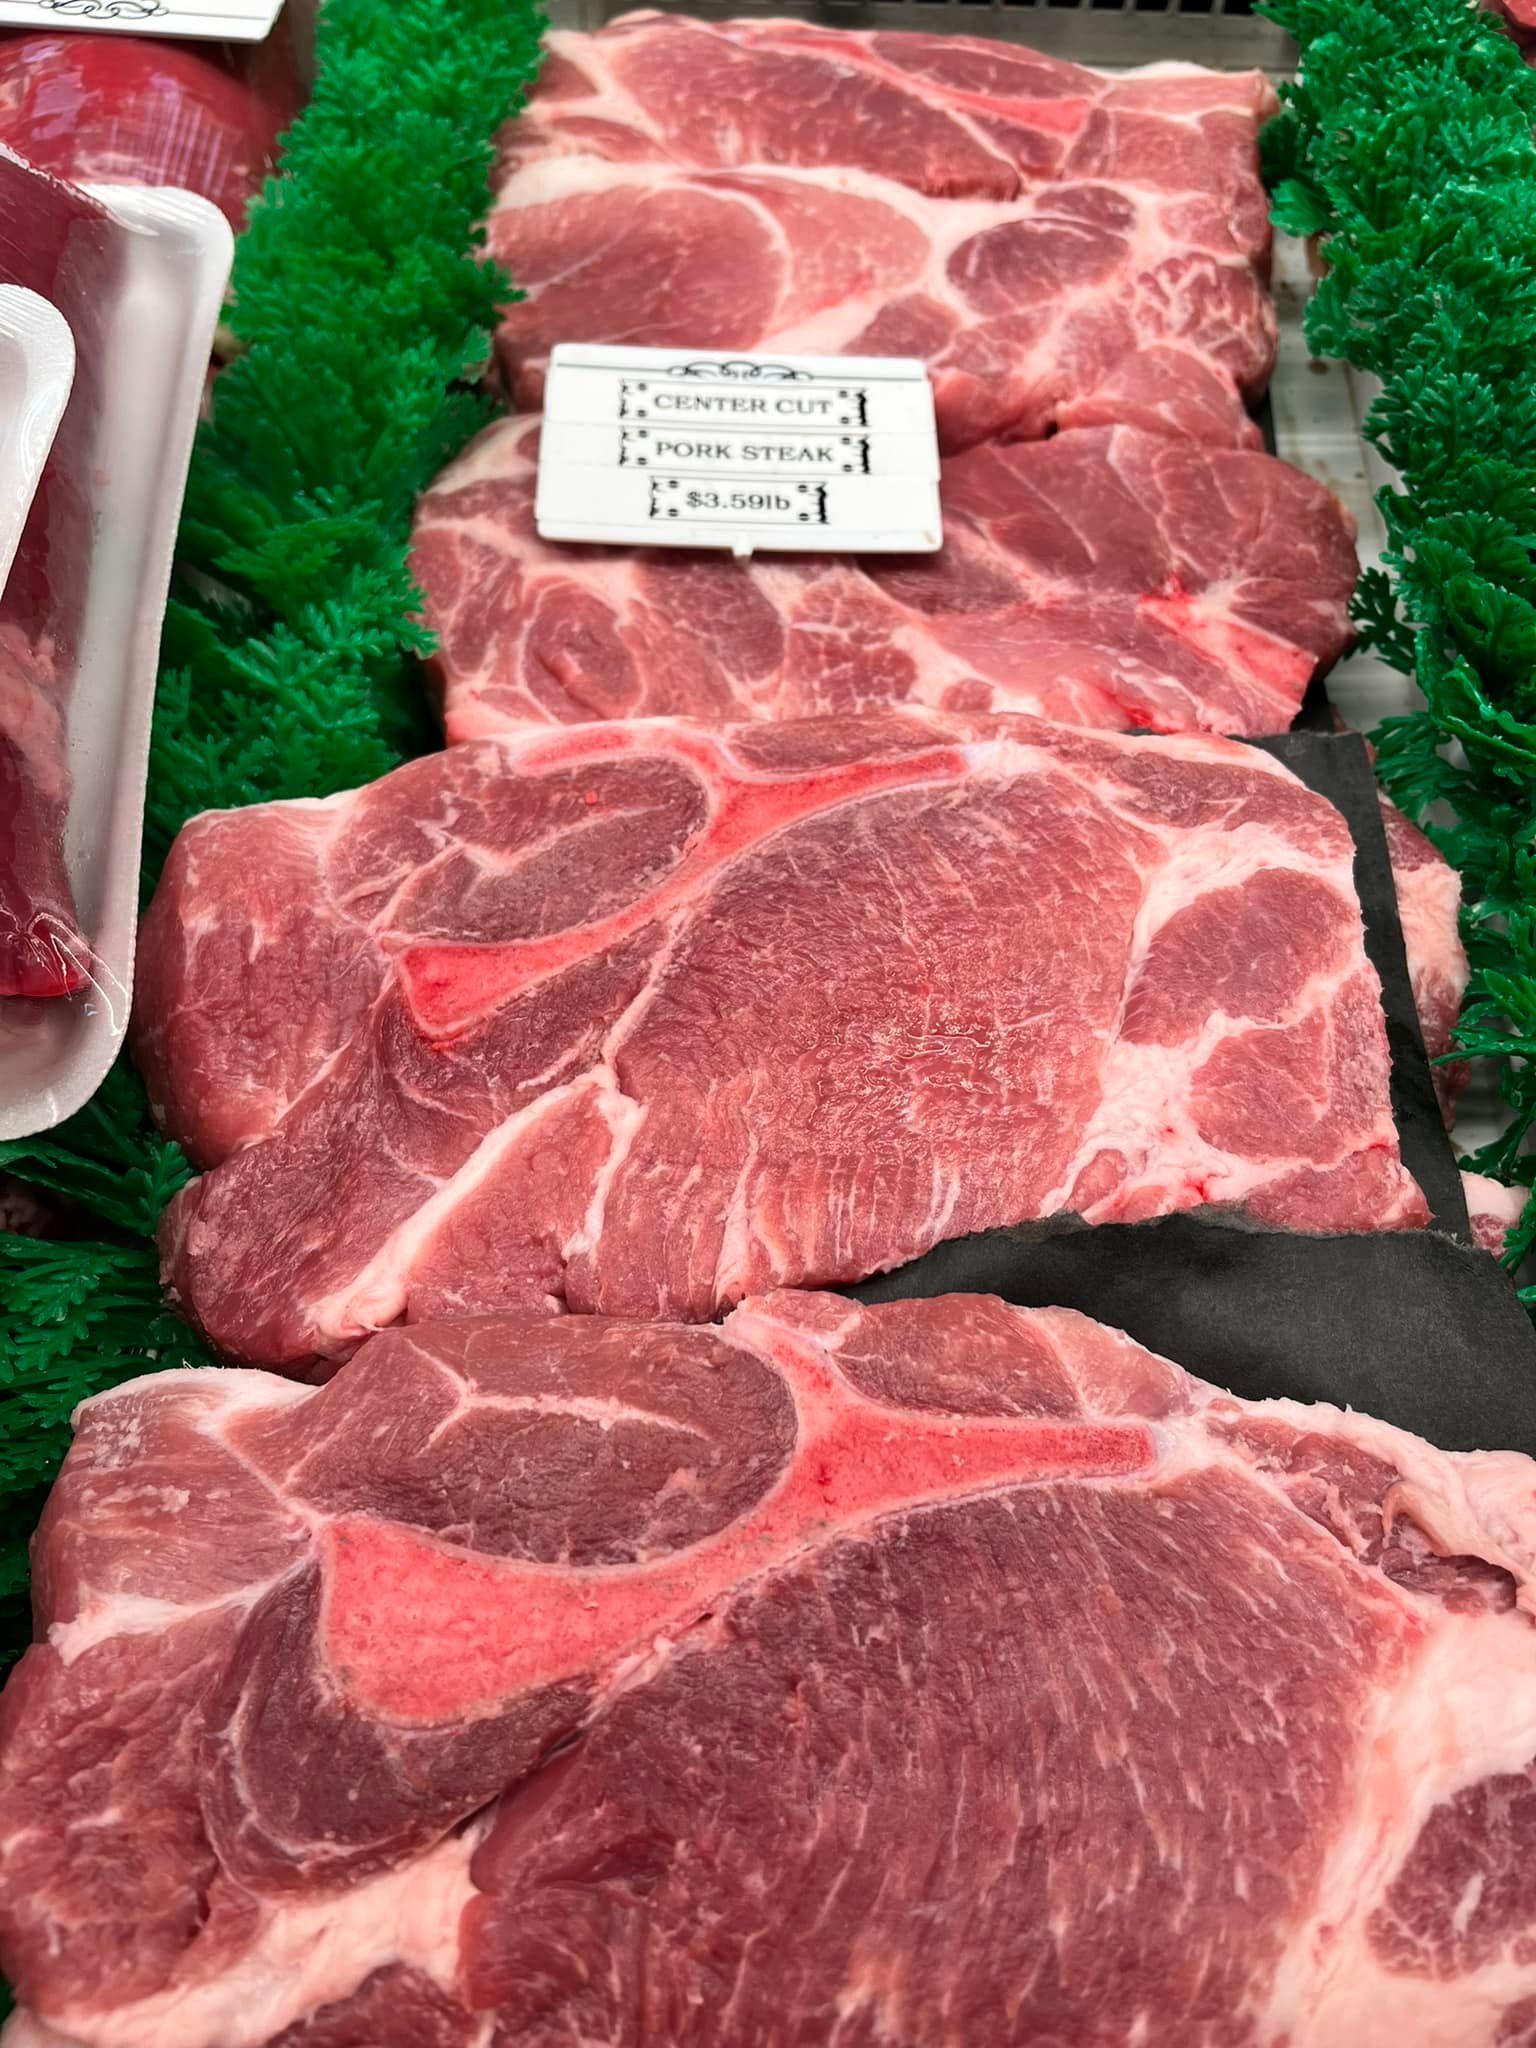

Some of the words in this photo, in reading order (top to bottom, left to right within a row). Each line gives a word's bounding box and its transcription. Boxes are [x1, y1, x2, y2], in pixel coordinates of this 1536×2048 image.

[653, 393, 766, 414] CENTER
[775, 398, 834, 416] CUT
[656, 441, 731, 460] PORK
[741, 445, 834, 463] STEAK
[686, 491, 791, 511] $3.59lb
